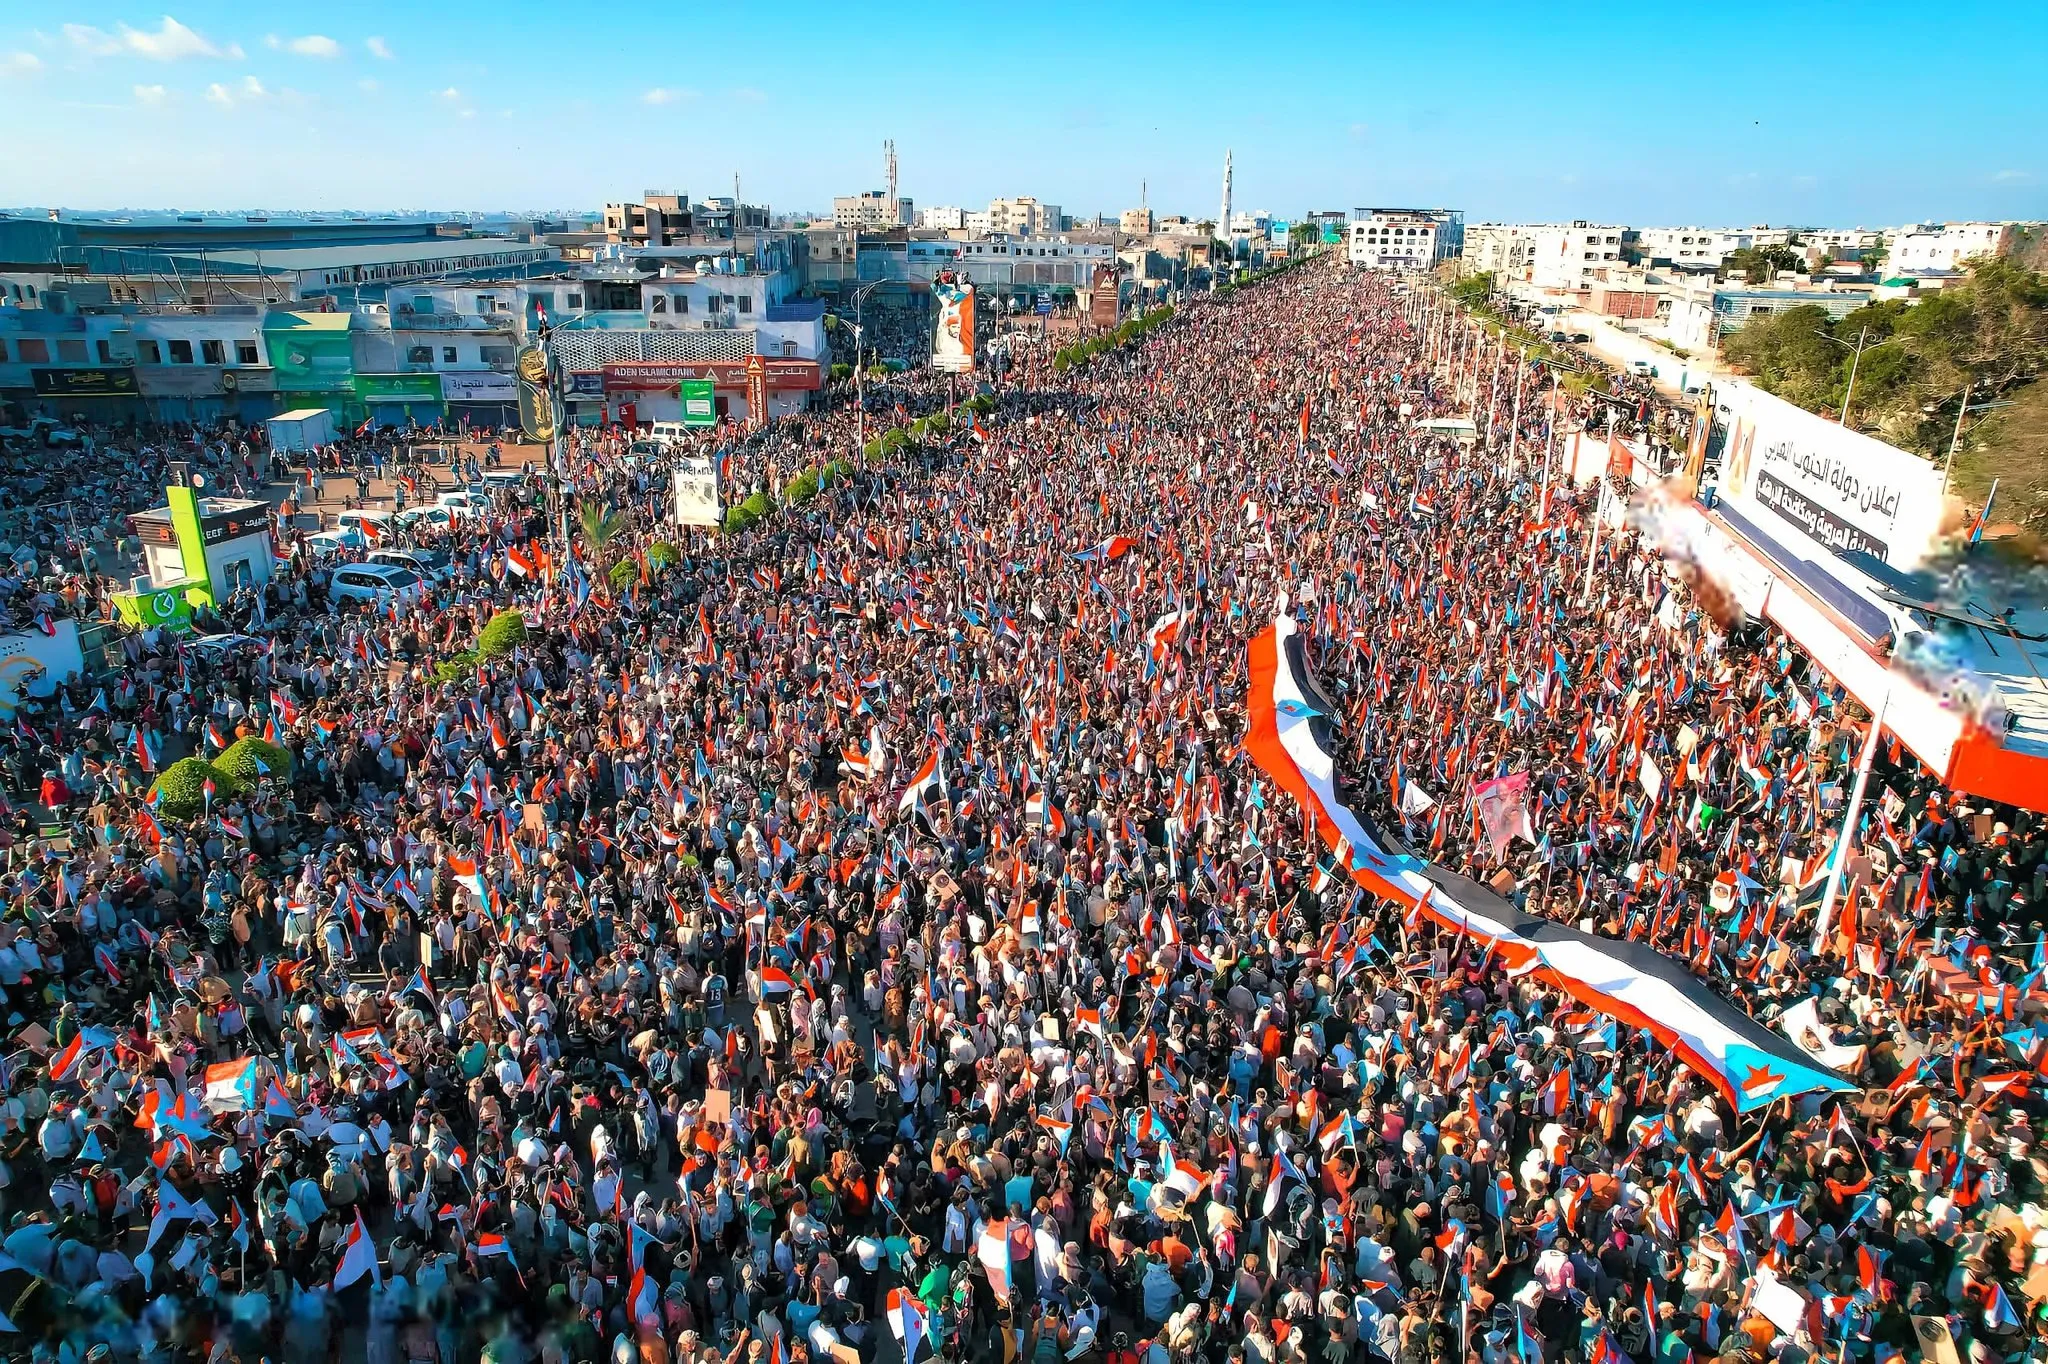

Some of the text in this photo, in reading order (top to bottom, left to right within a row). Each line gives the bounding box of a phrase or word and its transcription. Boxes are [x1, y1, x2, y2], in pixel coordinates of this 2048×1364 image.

[614, 367, 696, 377] ADEN ISLAMIC BANK
[1793, 452, 1831, 485] الجنوب
[1830, 460, 1859, 501] دولة
[1860, 485, 1901, 531] إعلان
[710, 989, 721, 1001] 13
